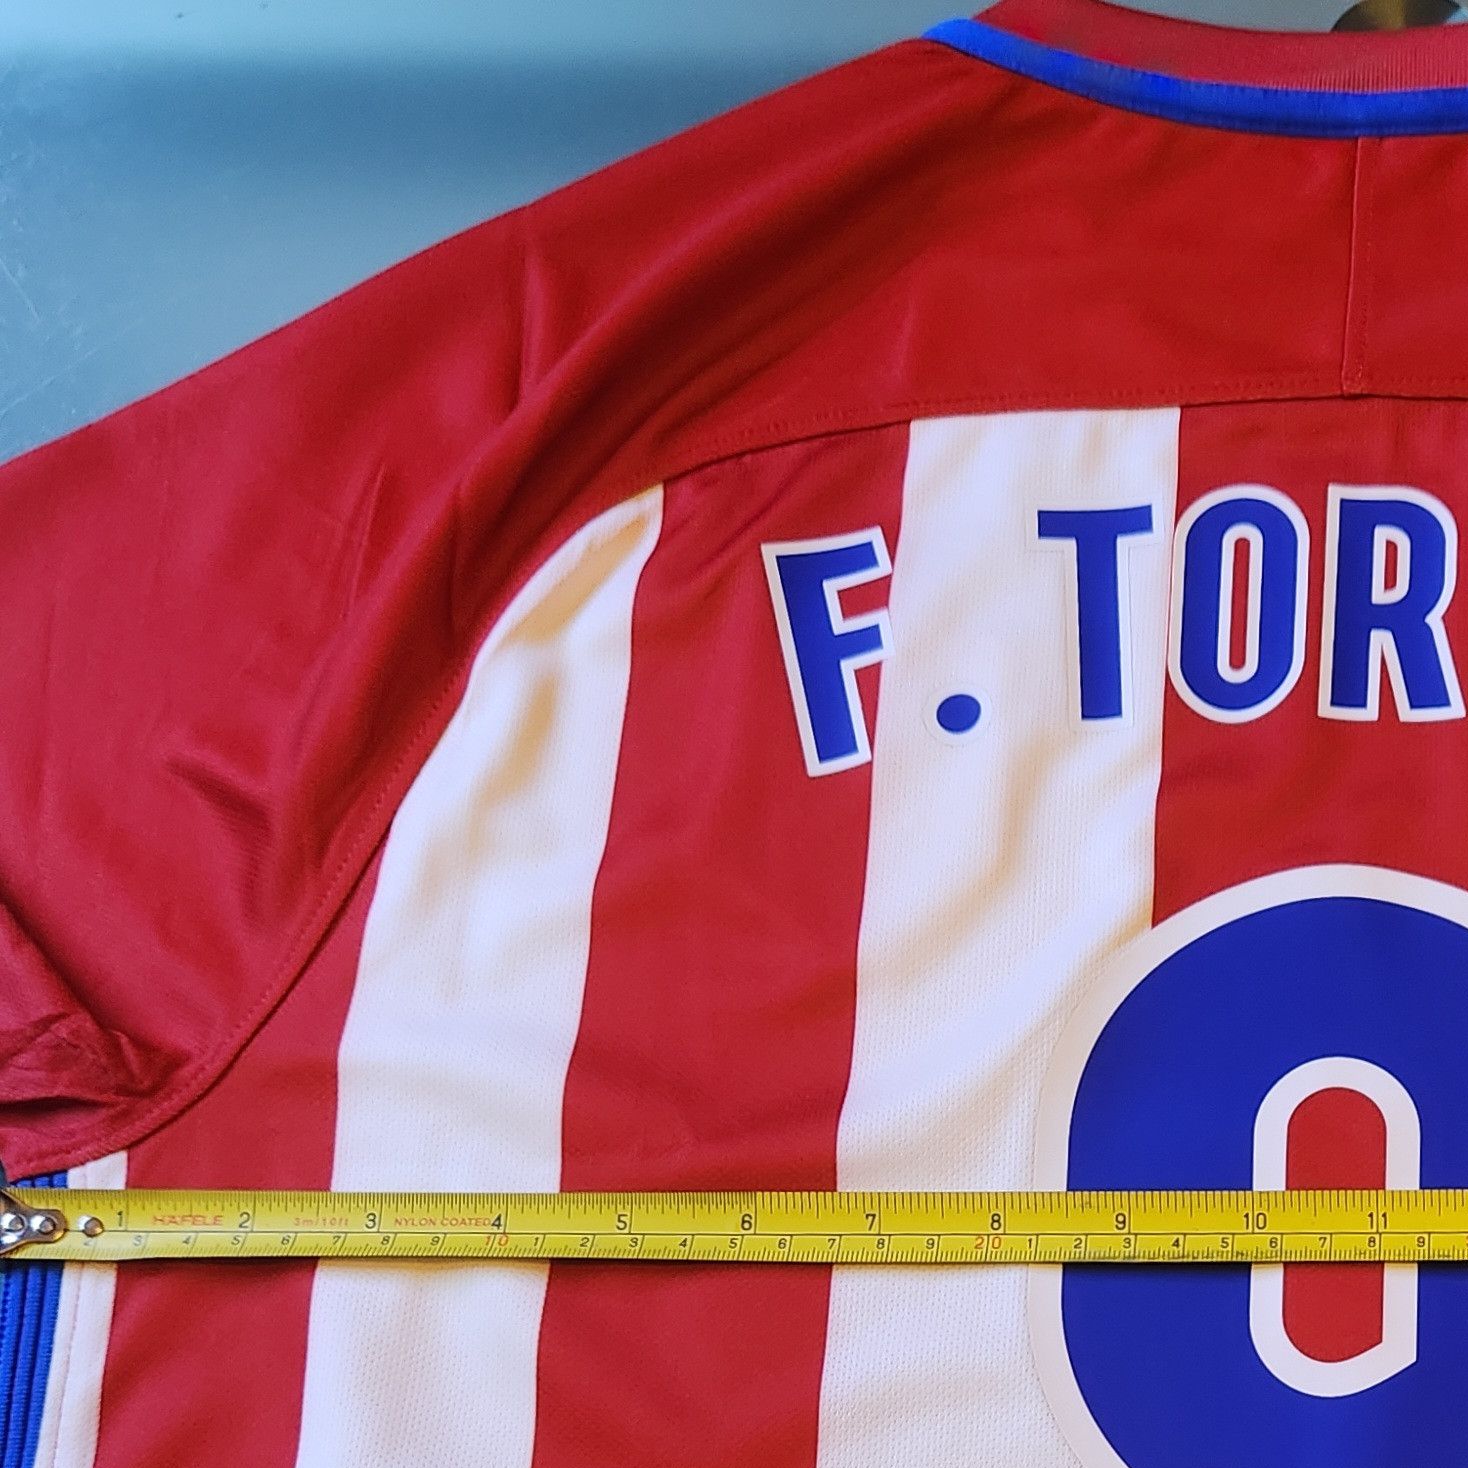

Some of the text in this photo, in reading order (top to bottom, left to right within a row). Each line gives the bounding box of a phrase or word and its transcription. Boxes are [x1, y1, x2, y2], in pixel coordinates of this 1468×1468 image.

[770, 535, 984, 774] F.
[117, 1210, 124, 1228] 1
[239, 1211, 251, 1229] 2
[365, 1212, 377, 1230] 3
[395, 1217, 436, 1227] NYLON
[440, 1217, 491, 1227] COATED
[491, 1213, 503, 1230] 4
[616, 1214, 628, 1231] 5
[741, 1213, 753, 1231] 6
[865, 1213, 877, 1231] 7
[990, 1213, 1002, 1231] 8
[1115, 1212, 1127, 1230] 9
[1243, 1212, 1267, 1230] 10
[1367, 1211, 1388, 1230] 11
[182, 1234, 192, 1245] 4
[231, 1234, 241, 1246] 5
[281, 1235, 291, 1246] 6
[332, 1235, 342, 1246] 7
[381, 1235, 391, 1246] 8
[430, 1236, 440, 1246] 9
[533, 1236, 539, 1247] 1
[579, 1236, 590, 1248] 2
[629, 1237, 639, 1248] 3
[678, 1237, 689, 1249] 4
[728, 1238, 739, 1249] 5
[777, 1238, 787, 1249] 6
[827, 1238, 837, 1249] 7
[876, 1238, 886, 1249] 8
[925, 1238, 935, 1249] 9
[1027, 1238, 1033, 1249] 1
[1073, 1238, 1083, 1249] 2
[1122, 1237, 1132, 1249] 3
[1171, 1237, 1180, 1249] 4
[1220, 1237, 1230, 1249] 5
[1269, 1237, 1279, 1249] 6
[1318, 1237, 1328, 1249] 7
[1367, 1236, 1377, 1248] 8
[1416, 1236, 1426, 1248] 9
